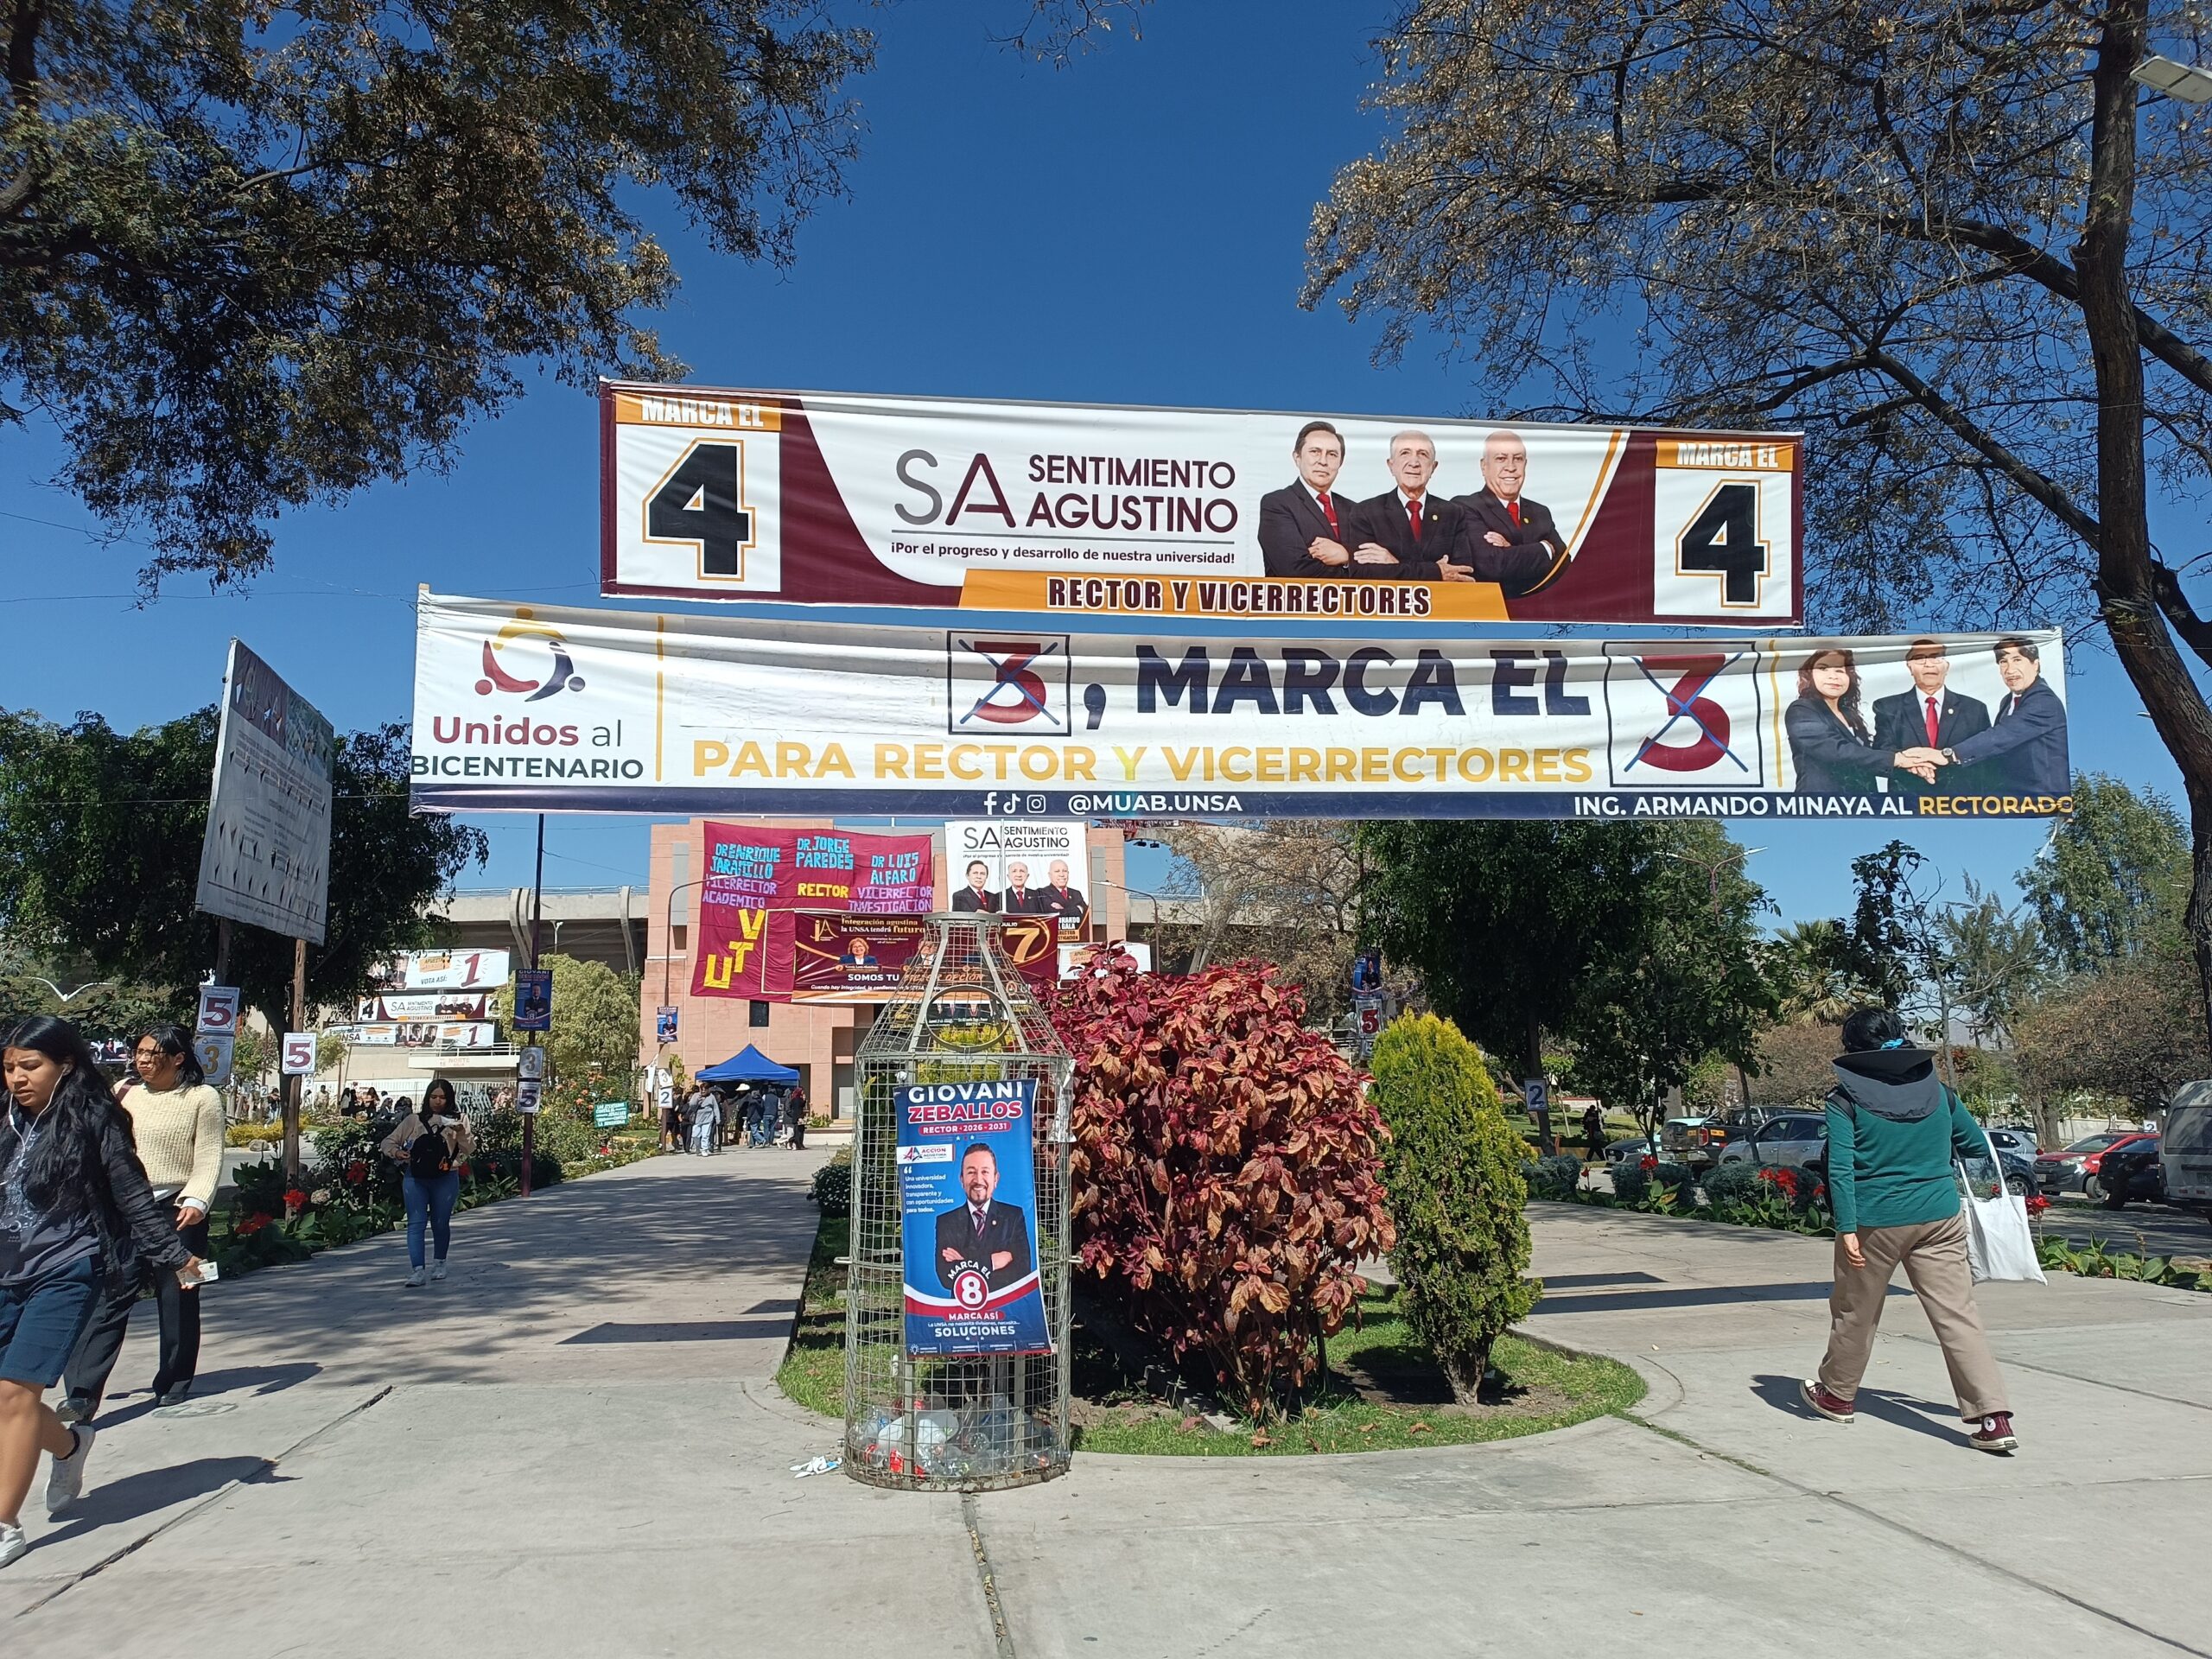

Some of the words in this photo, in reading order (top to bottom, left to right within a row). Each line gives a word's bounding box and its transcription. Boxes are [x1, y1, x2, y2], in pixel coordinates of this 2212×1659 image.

[641, 397, 733, 426] MARCA
[737, 403, 765, 427] EL
[1677, 442, 1752, 467] MARCA
[1757, 444, 1779, 468] EL
[1028, 454, 1236, 489] SENTIMIENTO
[894, 448, 1017, 528] SA
[645, 441, 753, 578] 4
[1026, 492, 1238, 533] AGUSTINO
[891, 542, 918, 555] ¡Por
[922, 543, 934, 555] el
[938, 546, 998, 560] progreso
[1001, 549, 1009, 560] y
[1014, 546, 1079, 560] desarrollo
[1083, 549, 1099, 560] de
[1103, 550, 1152, 562] nuestra
[1156, 550, 1236, 563] universidad!
[1678, 482, 1767, 605] 4
[1047, 577, 1163, 610] RECTOR
[1171, 582, 1191, 611] Y
[1198, 581, 1432, 616] VICERRECTORES
[1135, 645, 1466, 716] MARCA
[1491, 649, 1591, 715] EL
[1640, 654, 1730, 772] 3
[433, 715, 579, 747] Unidos
[591, 719, 622, 747] al
[410, 754, 644, 780] BICENTENARIO
[693, 740, 855, 779] PARA
[874, 743, 1096, 781] RECTOR
[1111, 746, 1146, 781] Y
[1161, 747, 1592, 783] VICERRECTORES
[1068, 793, 1243, 814] @MUAB.UNSA
[1574, 795, 1627, 816] ING.
[1633, 796, 1769, 817] ARMANDO
[1776, 796, 1873, 817] MINAYA
[1880, 796, 1913, 816] AL
[1919, 795, 2073, 816] RECTORADO
[1004, 826, 1068, 836] SENTIMIENTO
[812, 836, 849, 853] JORGE
[1004, 837, 1070, 848] AGUSTINO
[796, 852, 854, 870] PAREDES
[871, 855, 885, 868] DR
[888, 852, 918, 868] LUIS
[870, 868, 916, 886] ALFARO
[798, 883, 849, 898] RECTOR
[857, 886, 932, 899] VICERRECTOR
[1007, 928, 1039, 963] 7
[421, 976, 435, 985] VOTA
[461, 953, 480, 988] 1
[202, 998, 232, 1026] 5
[1362, 1008, 1379, 1034] 5
[467, 1026, 478, 1046] 1
[202, 1046, 219, 1074] 3
[286, 1043, 310, 1067] 5
[525, 1053, 536, 1071] 3
[662, 1072, 668, 1083] 3
[520, 1090, 537, 1107] 5
[661, 1092, 670, 1103] 2
[908, 1082, 1022, 1103] GIOVANI
[1530, 1085, 1545, 1105] 2
[908, 1102, 1022, 1123] ZEBALLOS
[923, 1125, 958, 1134] RECTOR
[948, 1260, 979, 1280] MARCA
[981, 1266, 991, 1280] EL
[961, 1275, 982, 1305] 8
[983, 1311, 999, 1319] ASÍ
[935, 1325, 1015, 1338] SOLUCIONES
